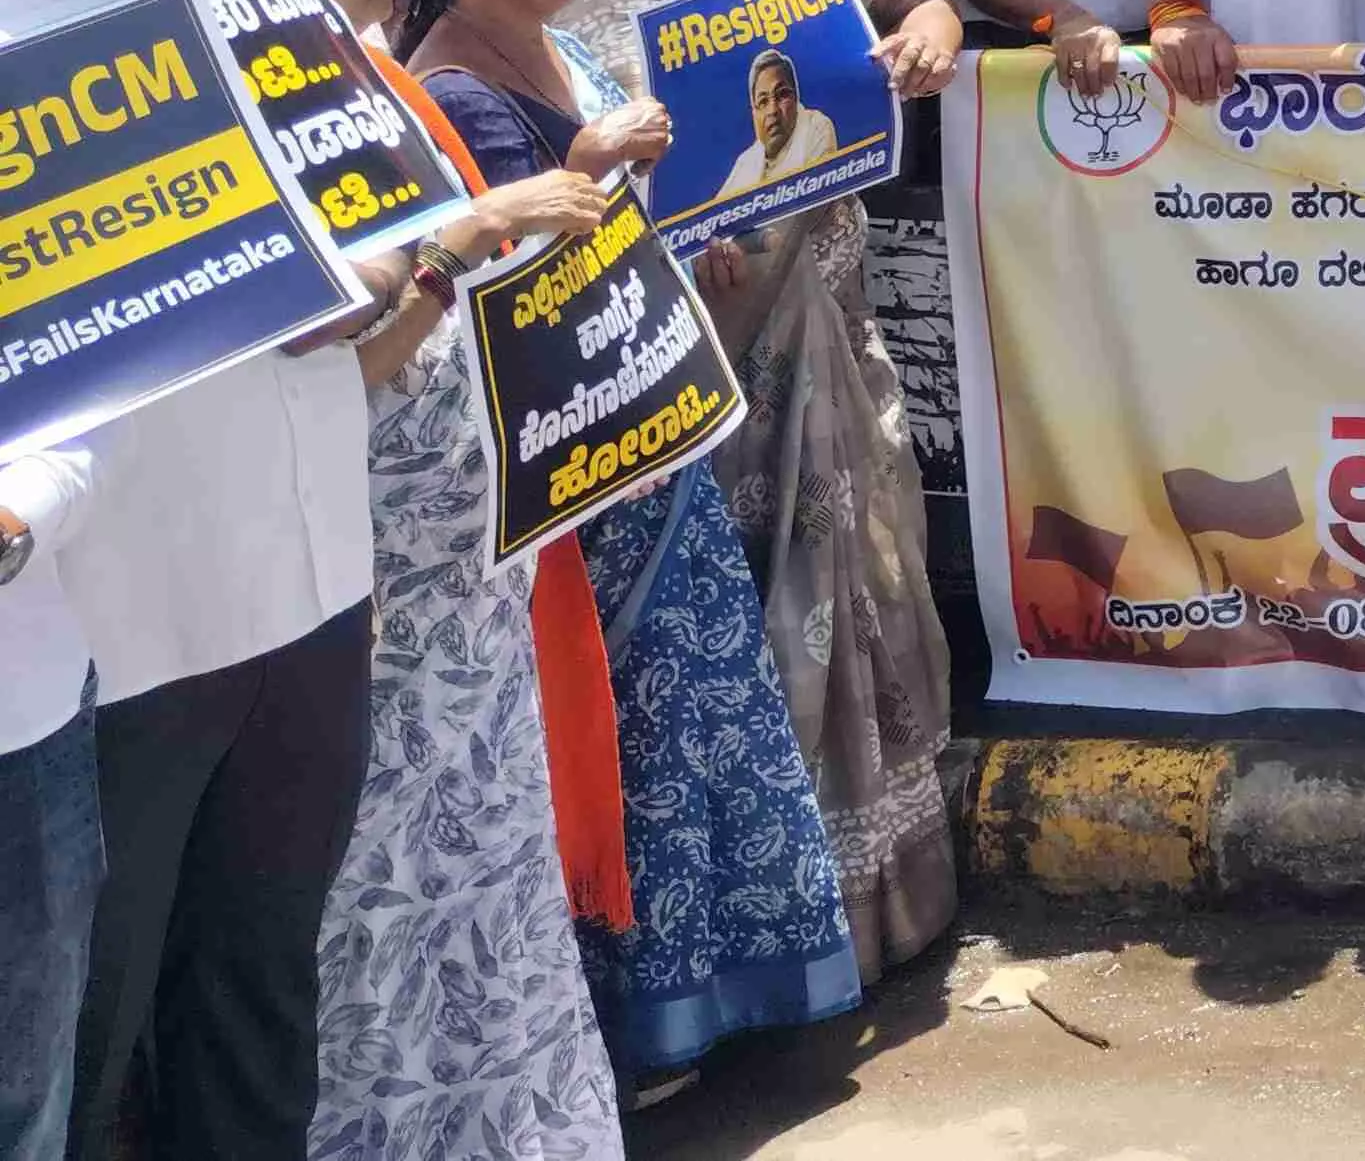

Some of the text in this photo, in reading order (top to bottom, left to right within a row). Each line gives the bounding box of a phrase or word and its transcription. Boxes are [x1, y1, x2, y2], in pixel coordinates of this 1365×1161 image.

[1153, 181, 1274, 221] ಮೂಡಾ
[1194, 249, 1299, 289] ಹಾಗೂ
[575, 272, 647, 360] ಕಾಂಗ್ರೆಸ್
[549, 383, 722, 506] ಹೋರಾಟ...
[1107, 586, 1244, 629] ದಿನಾಂಕ
